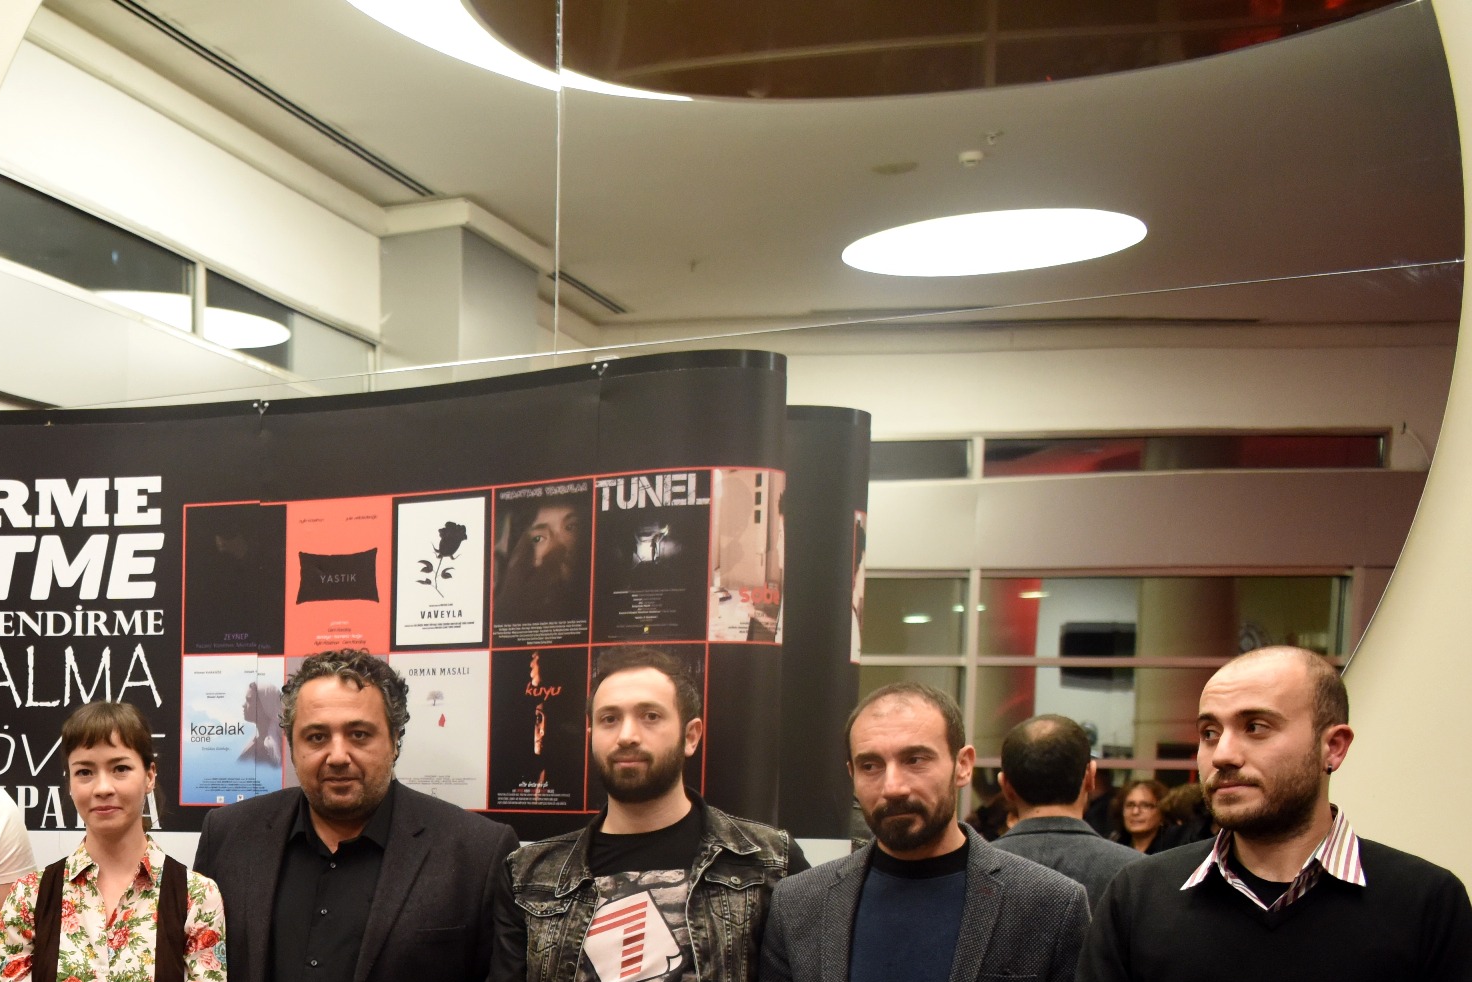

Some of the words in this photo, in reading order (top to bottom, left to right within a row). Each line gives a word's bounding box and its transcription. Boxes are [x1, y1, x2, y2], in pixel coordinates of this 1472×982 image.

[320, 573, 357, 584] YASTIK
[224, 633, 249, 641] ZEYNEP
[408, 668, 437, 677] ORMAN
[439, 666, 470, 676] MASALI
[190, 722, 245, 736] kozalak
[190, 734, 211, 743] cone
